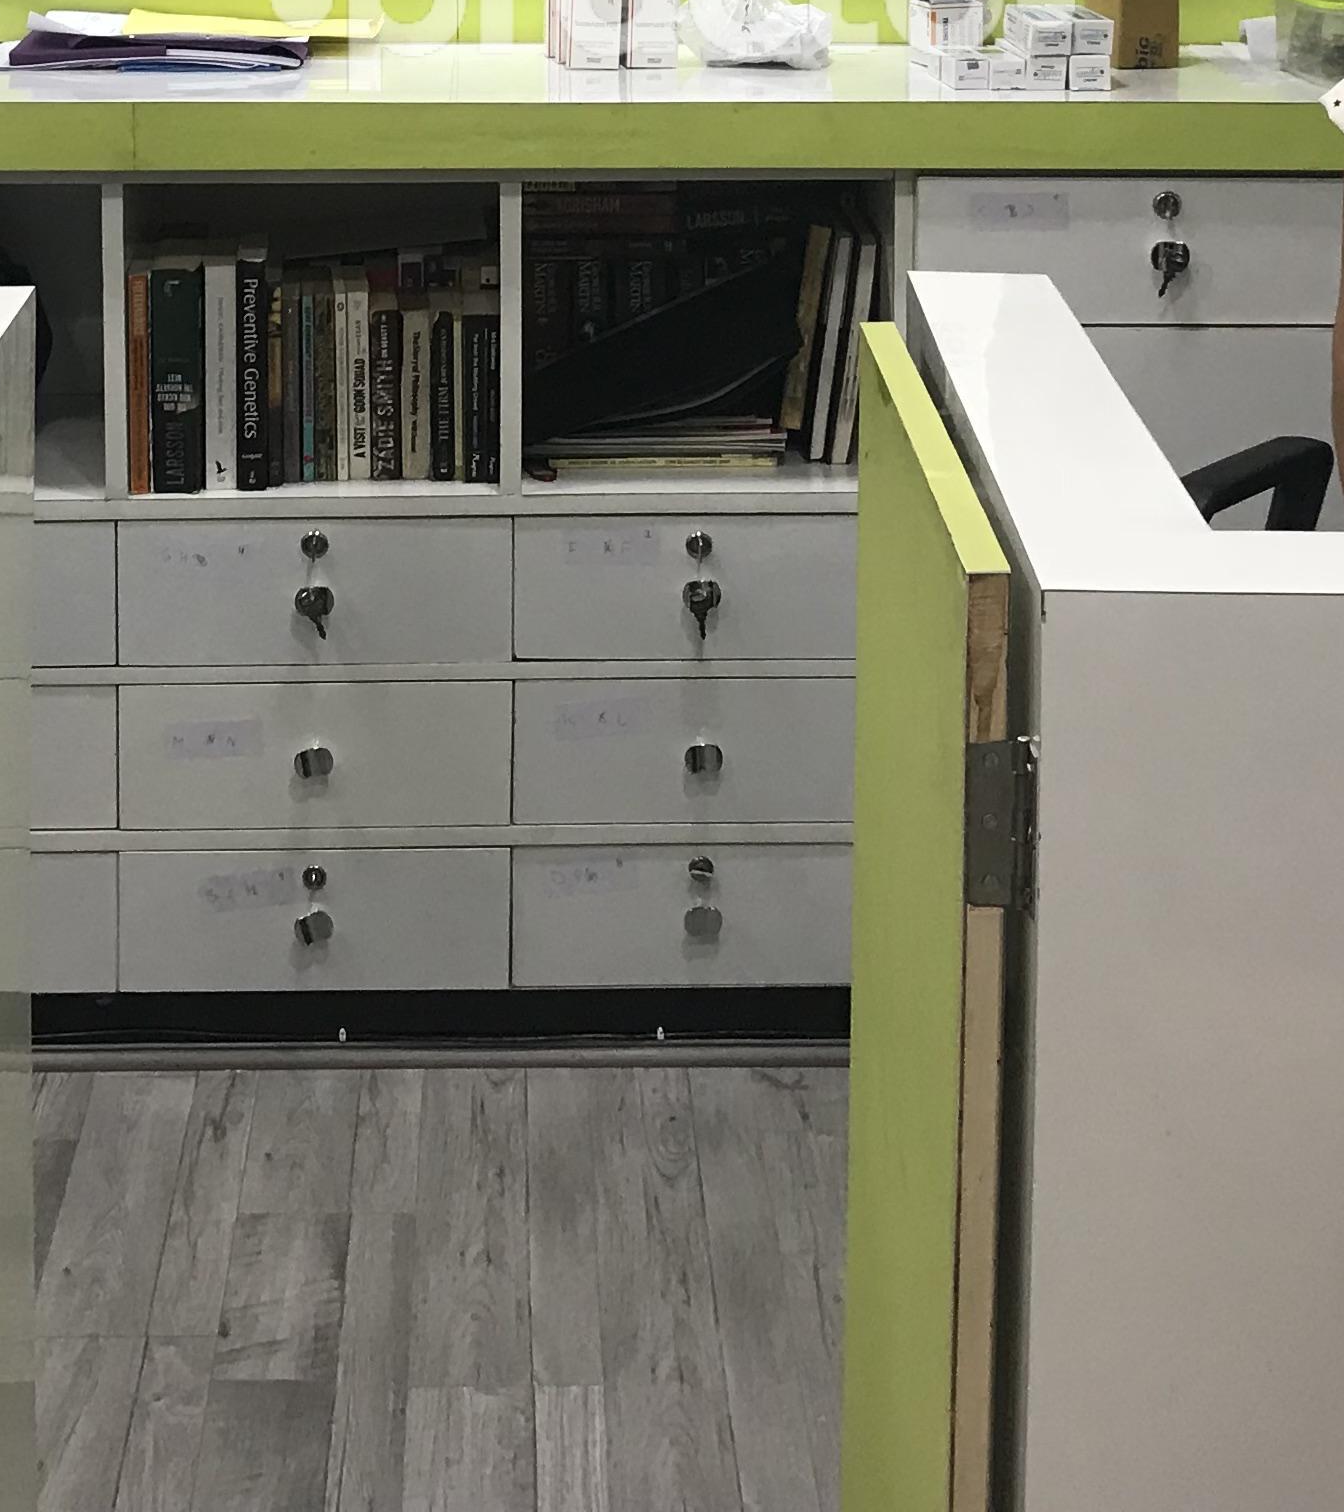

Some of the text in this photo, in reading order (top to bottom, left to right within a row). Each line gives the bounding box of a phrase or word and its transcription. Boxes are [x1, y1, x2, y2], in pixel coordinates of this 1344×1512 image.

[242, 278, 260, 363] Preventive
[243, 368, 261, 439] Genetics
[353, 358, 367, 388] SQUAD
[353, 388, 367, 413] GOON
[353, 427, 367, 450] VISIT
[374, 359, 395, 470] ZADIE SMITH
[164, 422, 185, 486] LARSSON
